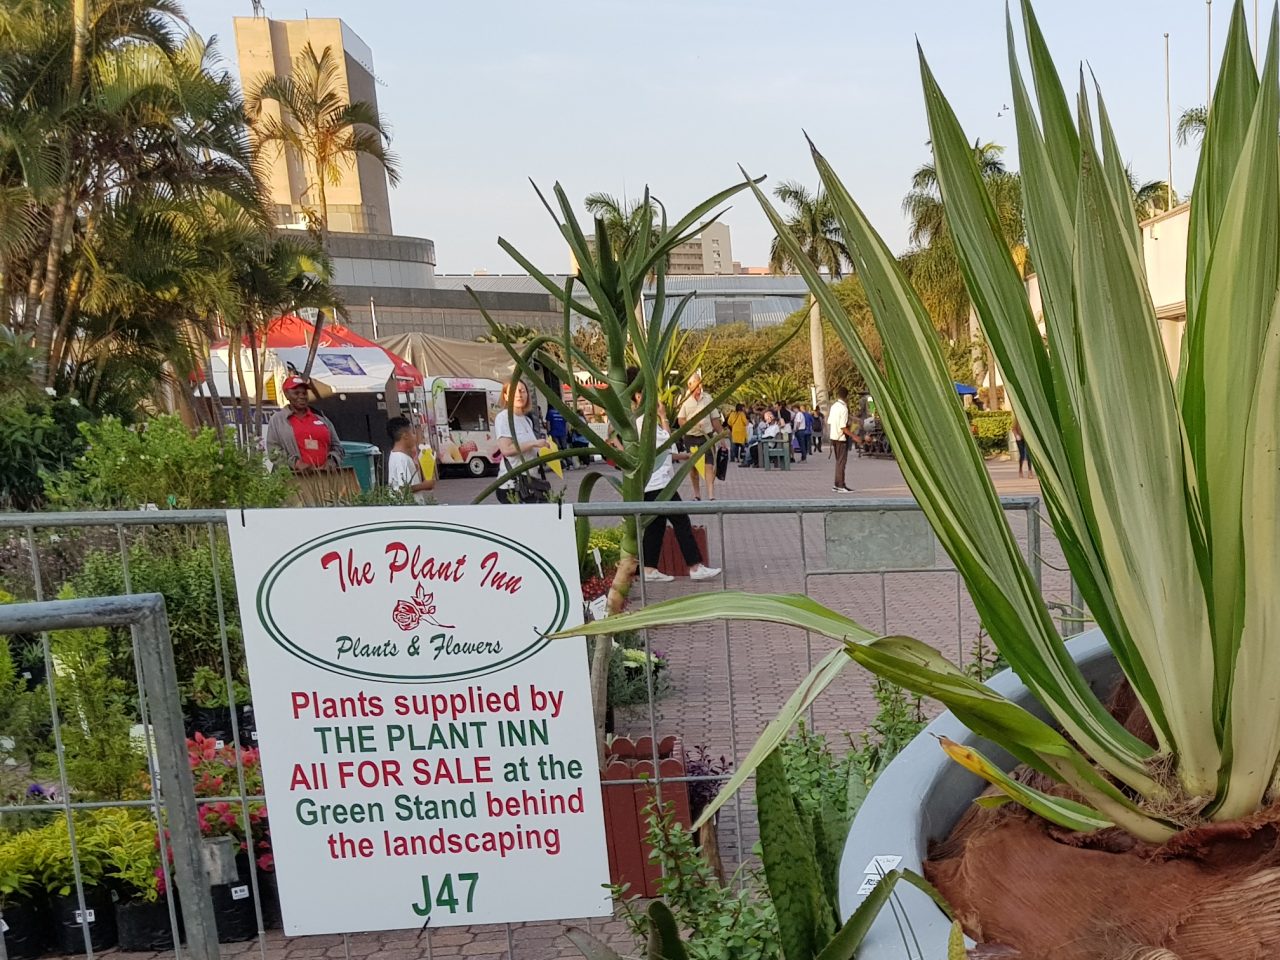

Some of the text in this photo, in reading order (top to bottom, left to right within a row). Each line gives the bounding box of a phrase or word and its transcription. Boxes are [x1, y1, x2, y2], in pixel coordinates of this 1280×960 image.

[320, 541, 523, 594] The Plant Inn
[335, 633, 504, 660] Plants & Flowers
[291, 684, 564, 721] Plants supplied by
[313, 718, 550, 754] THE PLANT INN
[289, 753, 583, 791] All FOR SALE at the
[295, 787, 585, 826] Green Stand behind
[327, 823, 561, 859] the landscaping
[411, 872, 480, 917] J47
